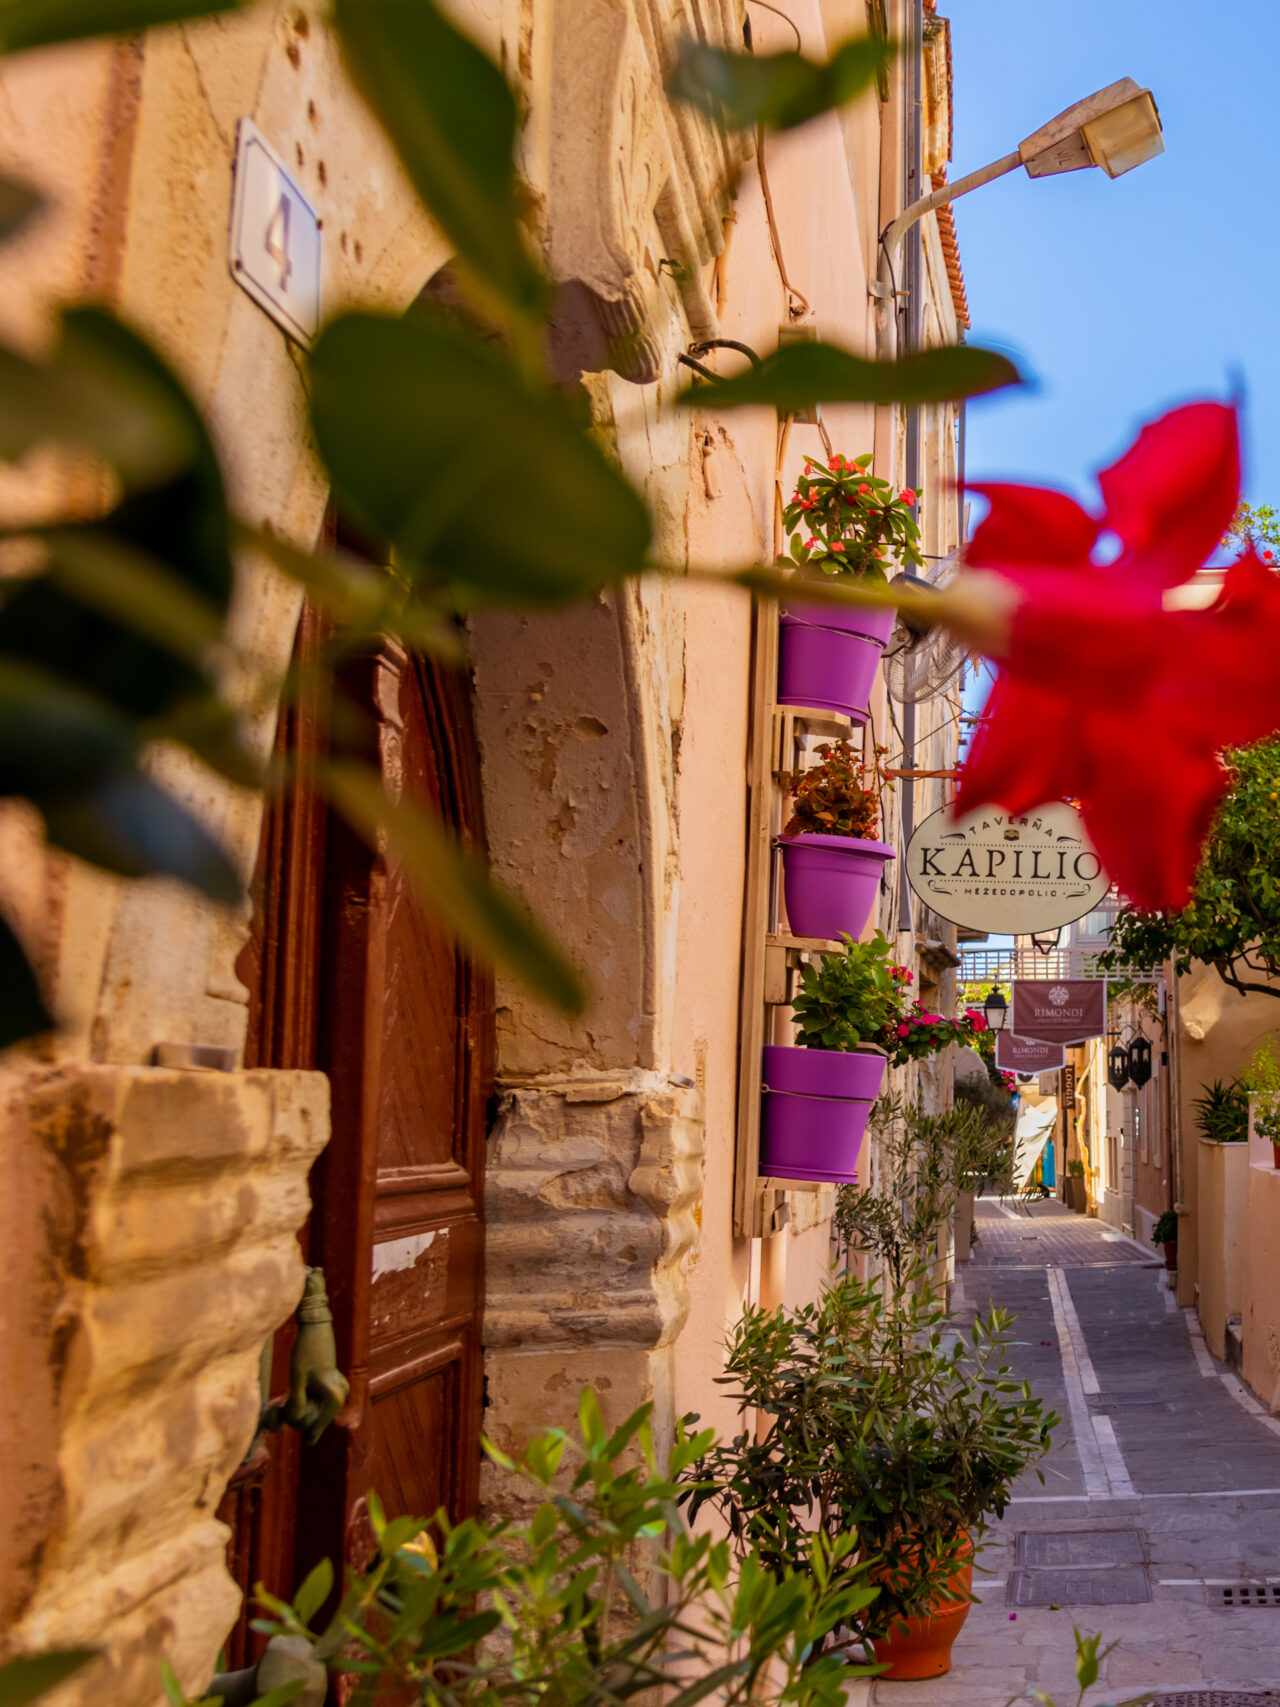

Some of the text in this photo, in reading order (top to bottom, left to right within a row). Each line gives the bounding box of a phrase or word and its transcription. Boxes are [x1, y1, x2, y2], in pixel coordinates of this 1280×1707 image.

[265, 191, 293, 293] 4
[919, 847, 1102, 881] KAPILIO
[964, 887, 1057, 897] MEZEDOPOLIO
[1034, 1008, 1083, 1017] RIMONDI
[1065, 1067, 1073, 1106] LOGGIA
